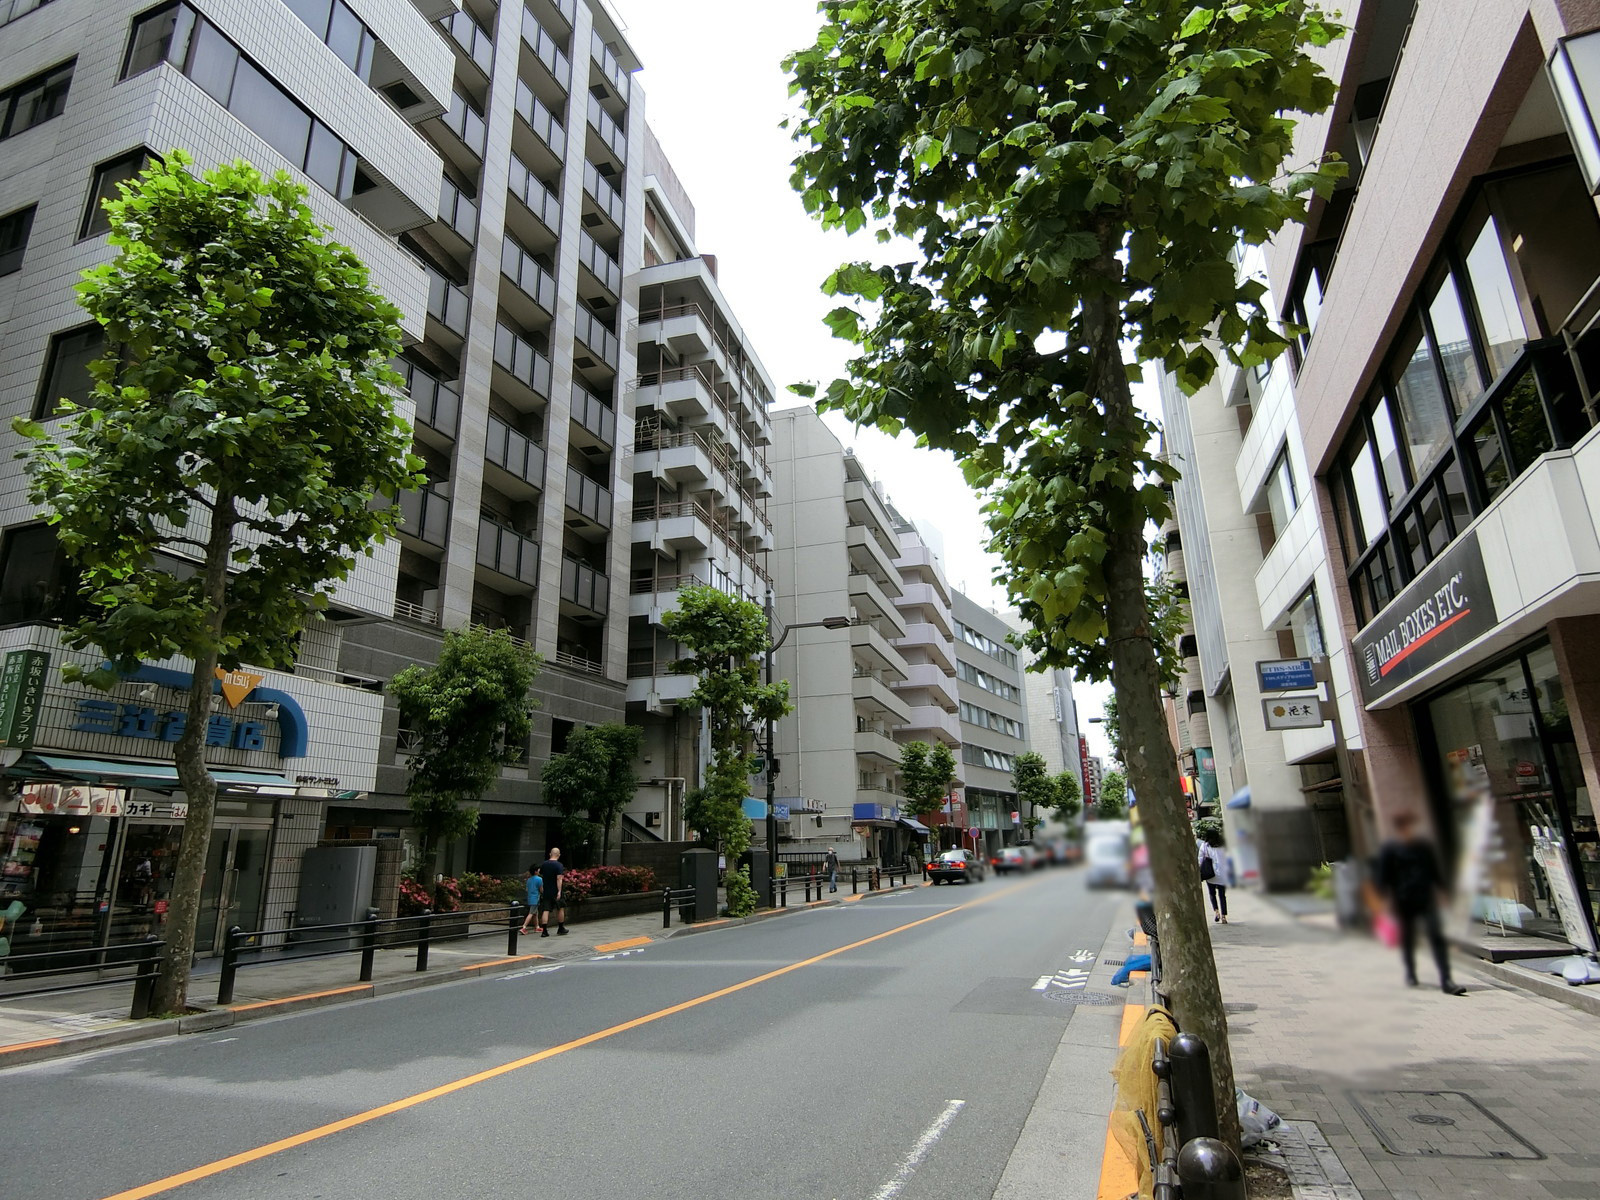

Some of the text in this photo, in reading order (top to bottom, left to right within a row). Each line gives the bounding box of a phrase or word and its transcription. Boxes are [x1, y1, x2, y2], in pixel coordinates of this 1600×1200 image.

[1375, 575, 1469, 666] MAIL BOXES ETC.
[16, 656, 44, 744] 赤坂いきいきプラザ
[126, 802, 153, 816] カギ
